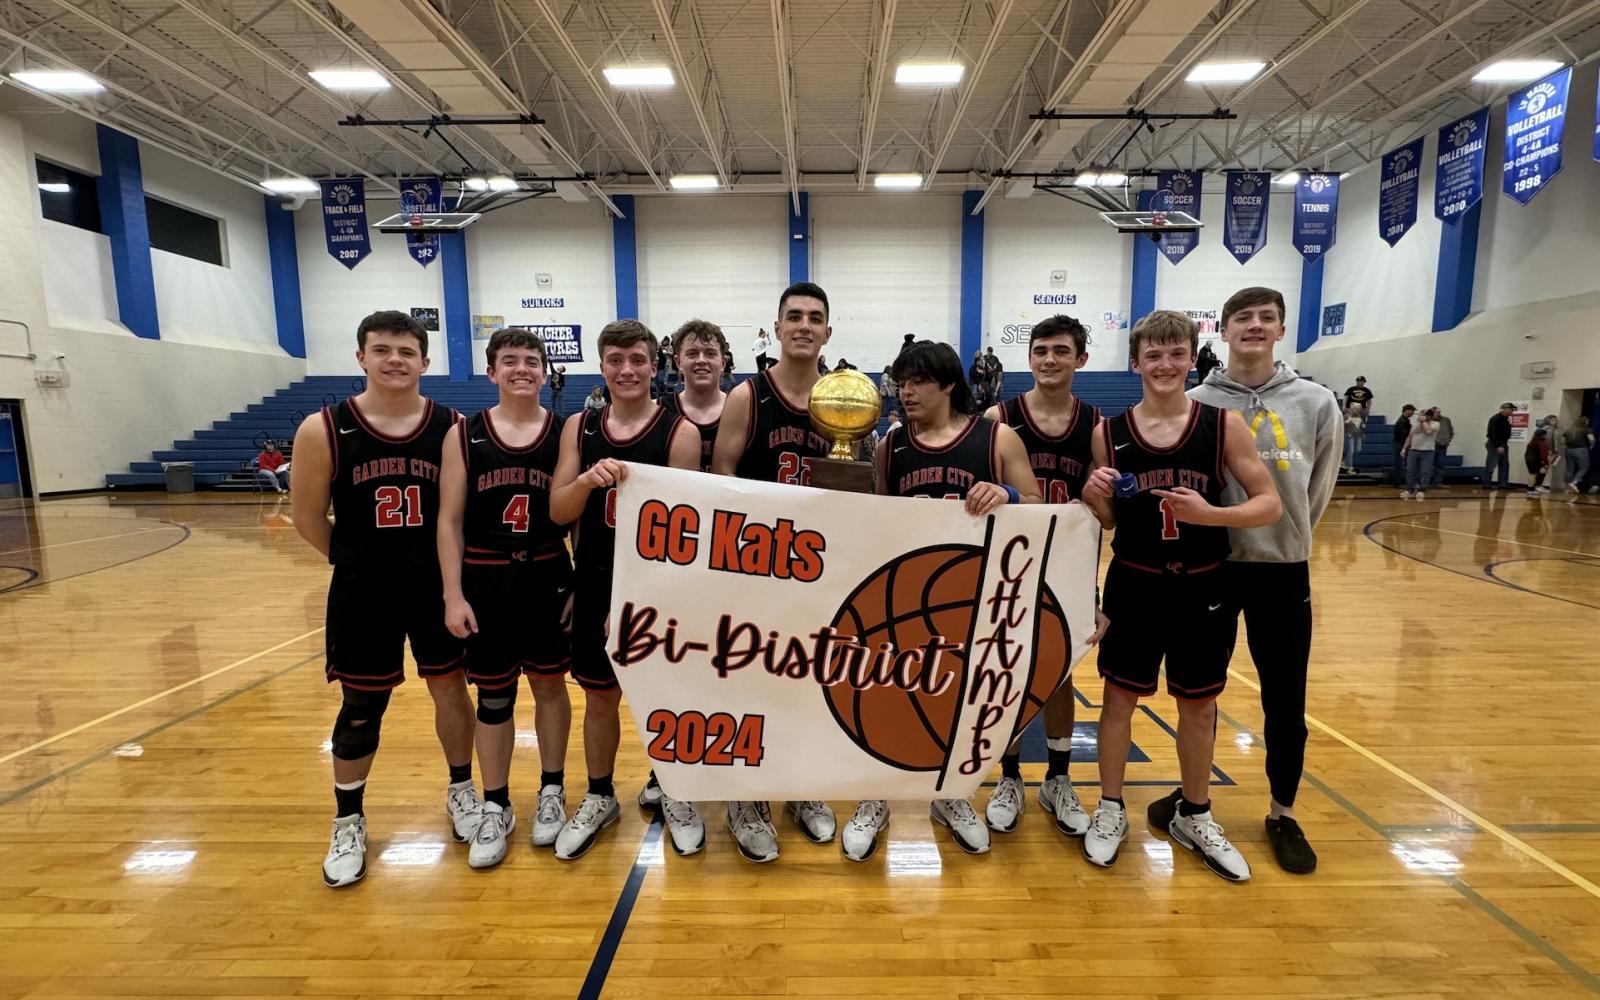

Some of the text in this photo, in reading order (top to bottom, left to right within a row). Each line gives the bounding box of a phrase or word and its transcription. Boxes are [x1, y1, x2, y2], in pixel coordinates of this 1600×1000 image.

[1507, 104, 1563, 137] VOLLEYBALL
[1516, 125, 1551, 147] DISTRICT
[1521, 140, 1542, 155] 4-4A
[1438, 138, 1483, 166] VOLLEYBALL
[1504, 143, 1560, 172] CO-CHAMPIONS
[1381, 168, 1419, 191] VOLLEYBALL
[1514, 179, 1542, 193] 1998
[324, 205, 344, 214] TRACK
[348, 204, 364, 214] FIELD
[1163, 195, 1194, 204] SOCCER
[1232, 196, 1263, 205] SOCCER
[1302, 203, 1330, 213] TENNIS
[339, 249, 360, 259] 2007
[1167, 245, 1185, 255] 2019
[1235, 245, 1253, 254] 2019
[1303, 244, 1321, 254] 2019
[522, 297, 563, 308] JUNIORS
[1034, 294, 1076, 304] SENIORS
[1185, 310, 1217, 319] REETINGS
[544, 341, 579, 356] TURES
[768, 425, 805, 449] GARDEN
[352, 457, 440, 486] GARDEN CITY
[477, 466, 526, 493] GARDEN
[899, 466, 975, 495] GARDEN CITY
[1138, 468, 1209, 494] RDEN CITY
[374, 485, 424, 528] 21
[502, 494, 530, 533] 4
[1159, 497, 1180, 541] 1
[635, 499, 700, 566] GC
[708, 508, 826, 583] Kats
[611, 600, 965, 698] Bi-District
[958, 533, 1033, 776] CHAMPS
[646, 708, 765, 767] 2024
